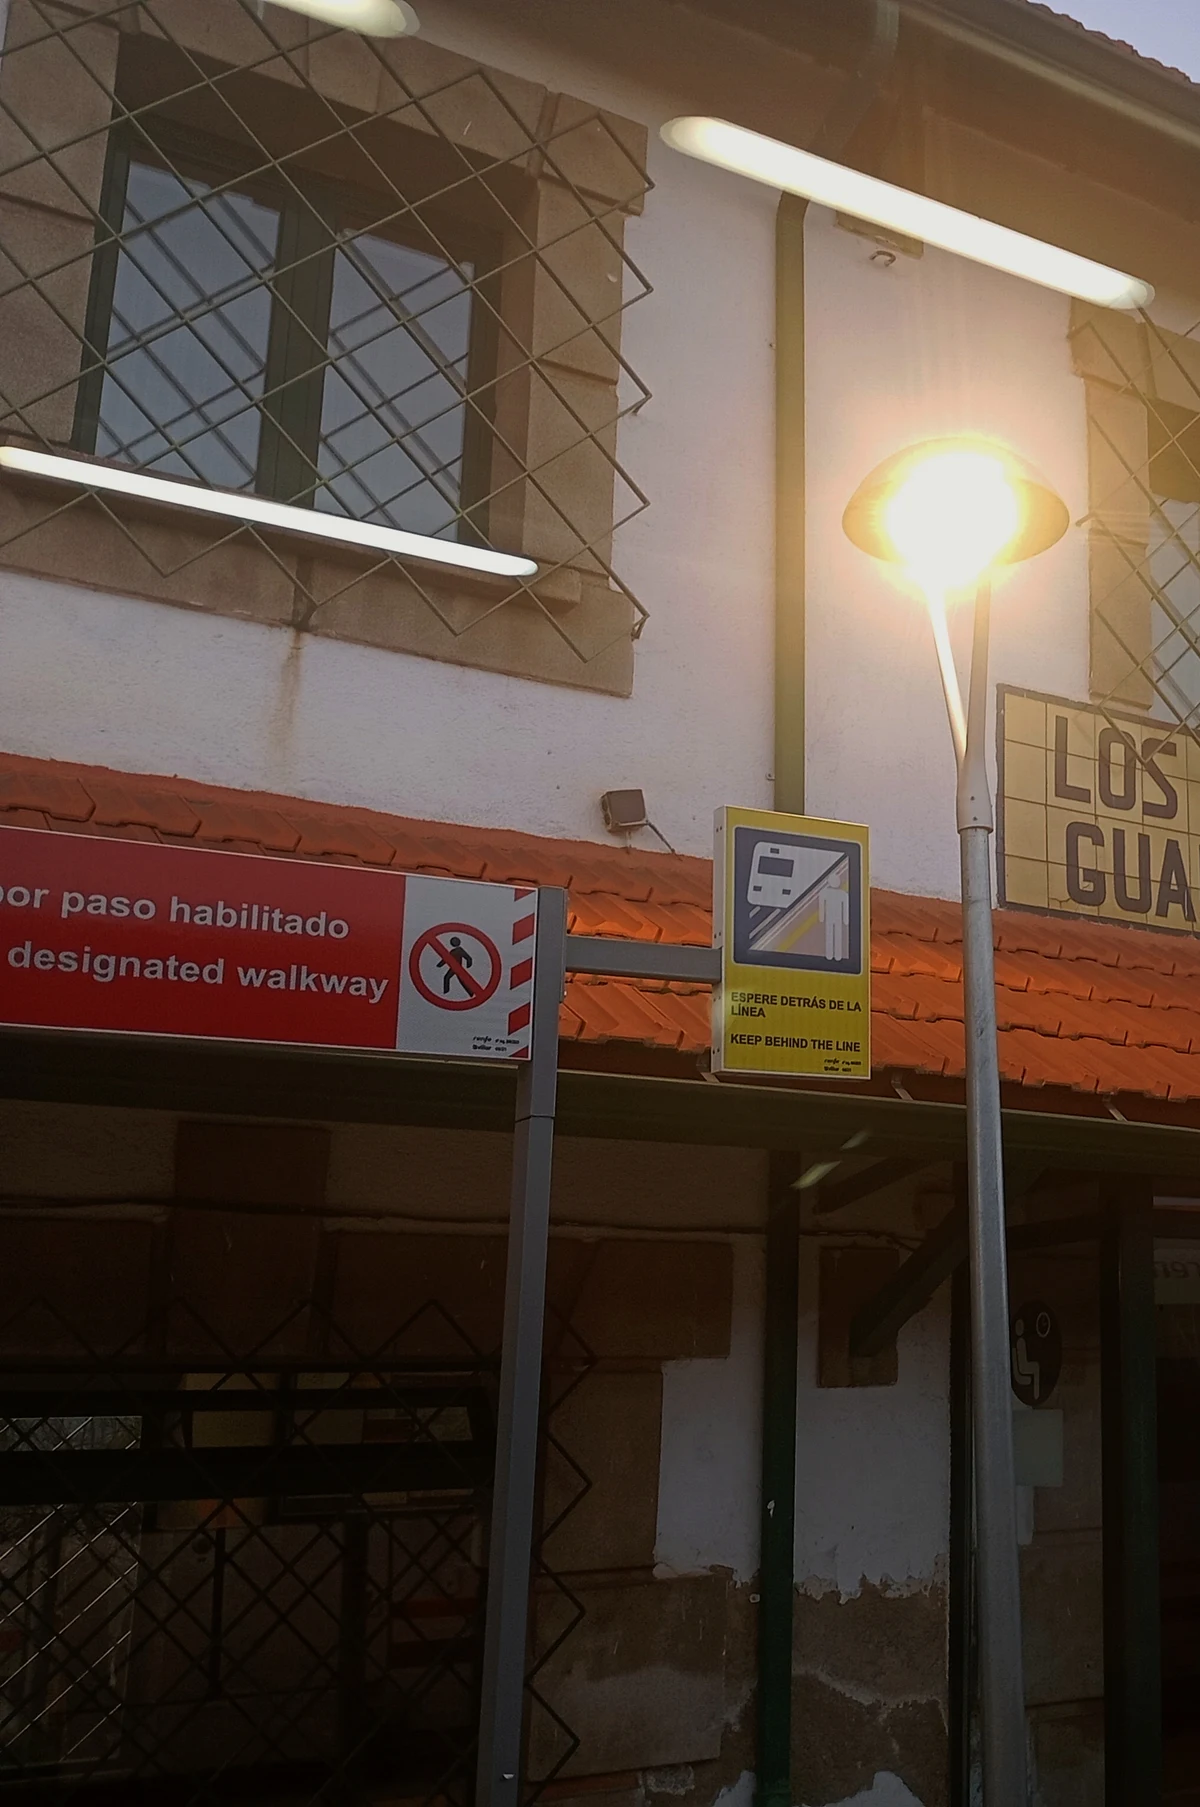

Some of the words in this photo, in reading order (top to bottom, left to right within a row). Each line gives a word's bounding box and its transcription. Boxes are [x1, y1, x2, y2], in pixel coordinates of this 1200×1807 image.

[1054, 715, 1178, 820] LOS
[0, 885, 50, 909] or
[61, 889, 156, 919] paso
[169, 895, 350, 940] habilitado
[7, 940, 225, 983] designated
[237, 962, 389, 1005] walkway
[731, 991, 777, 1006] ESPERE
[780, 995, 826, 1011] DETRÁS
[829, 999, 844, 1011] DE
[847, 1001, 862, 1013] LA
[731, 1002, 766, 1018] LÍNEA
[730, 1033, 762, 1046] KEEP
[764, 1036, 808, 1050] BEHIND
[810, 1039, 833, 1052] THE
[835, 1040, 861, 1053] LINE
